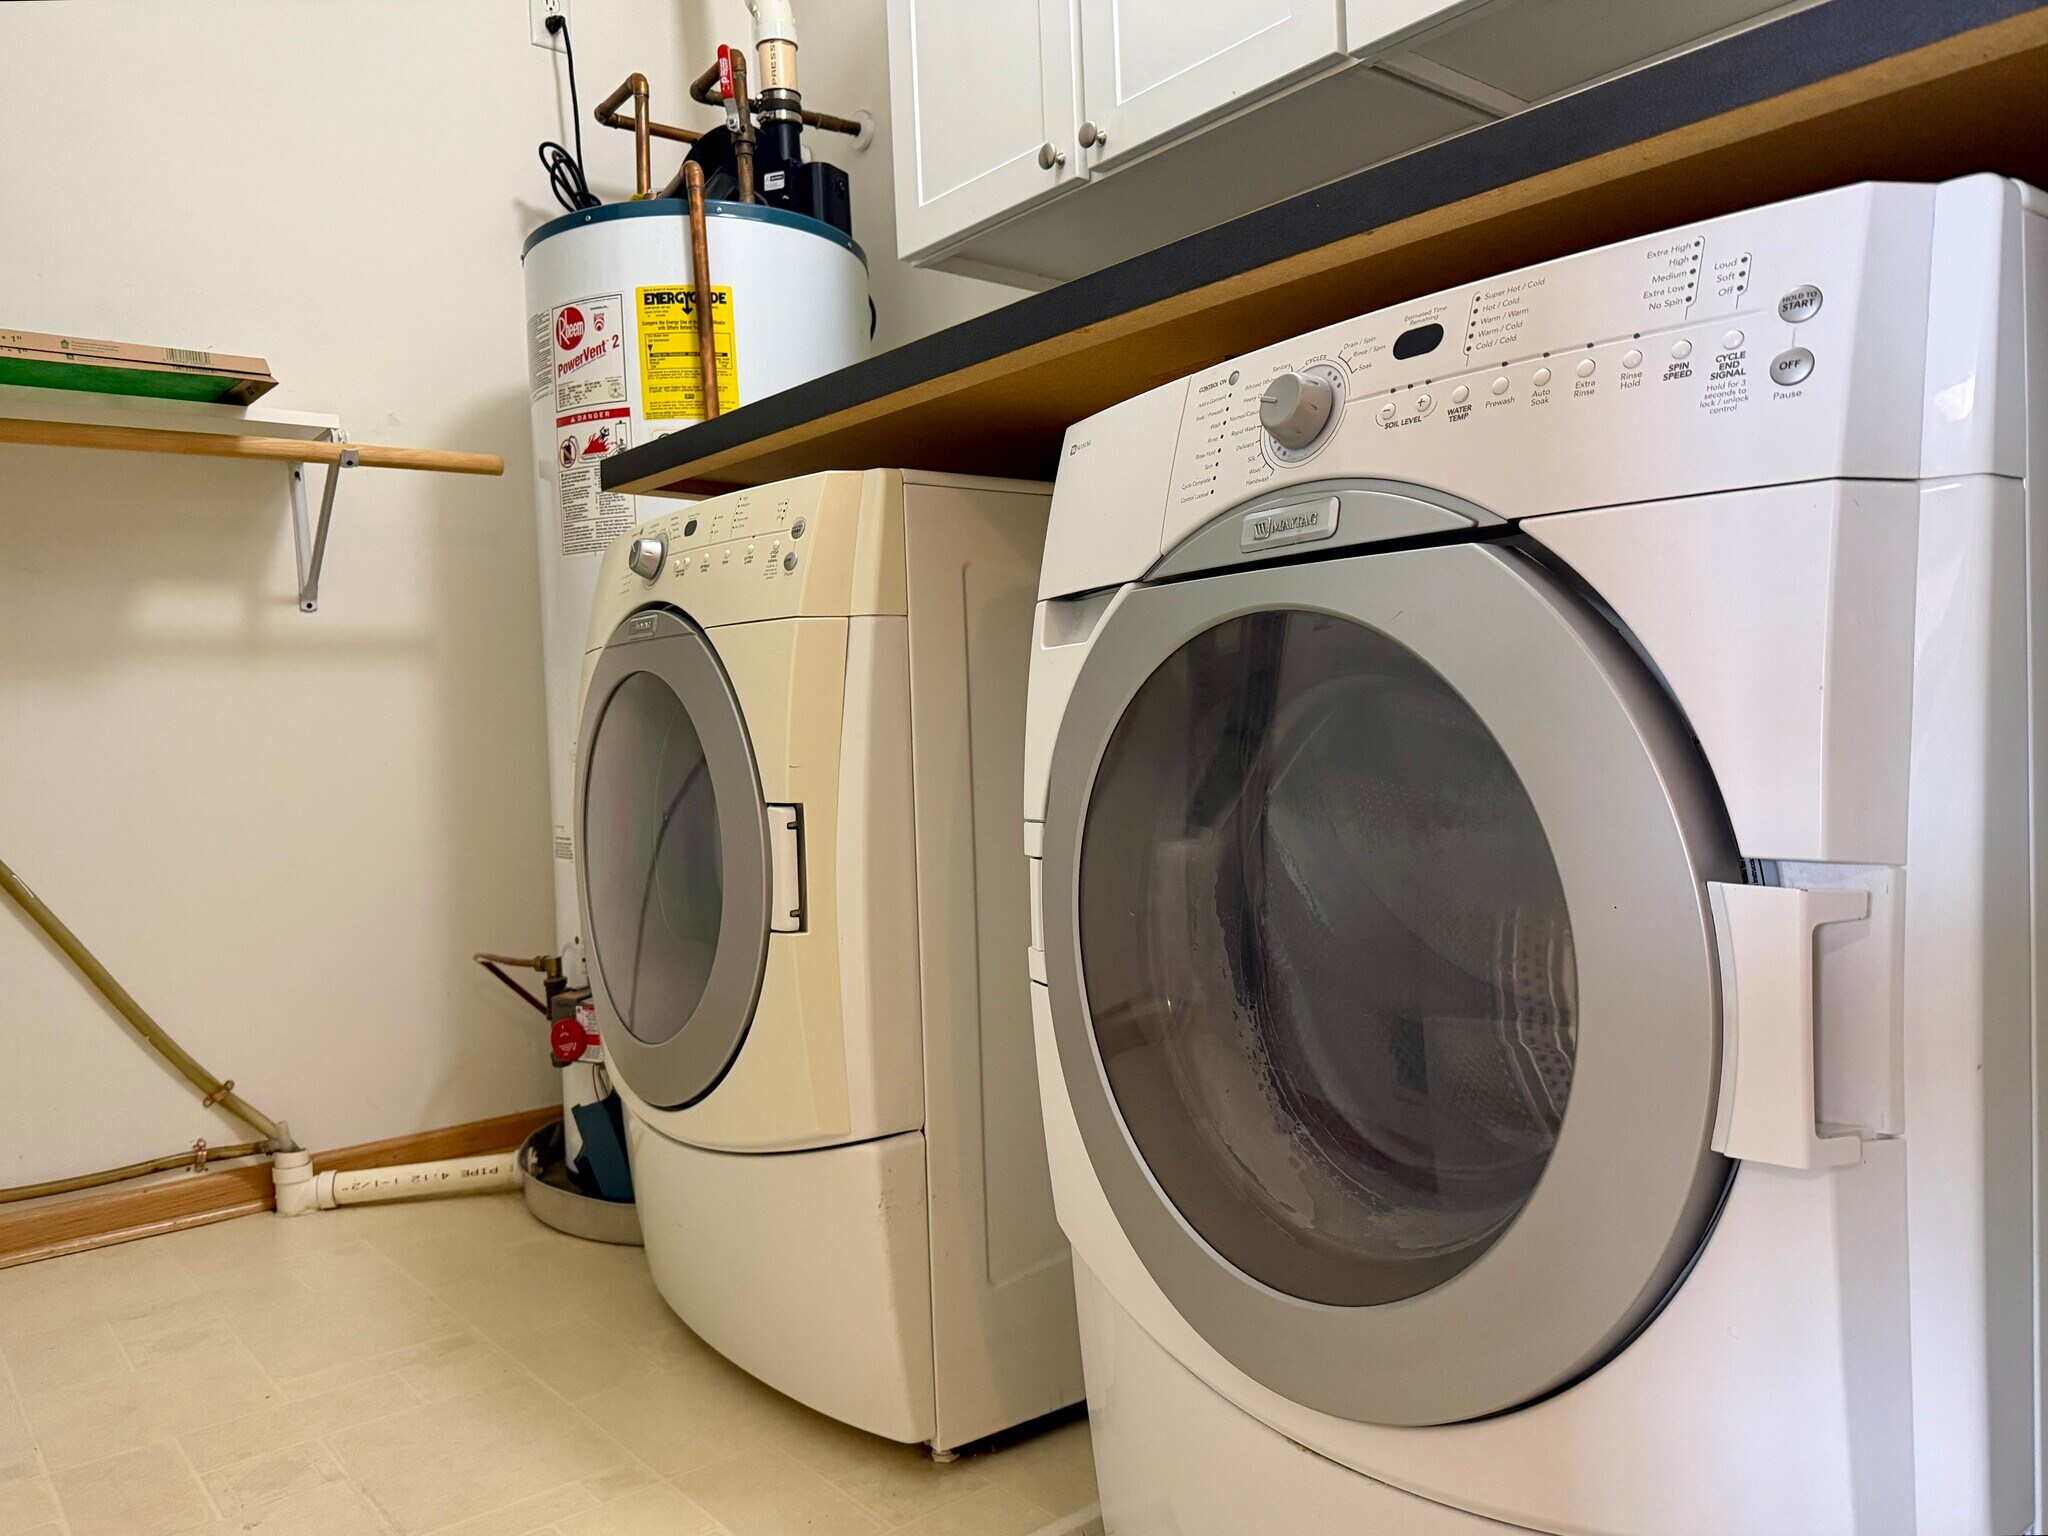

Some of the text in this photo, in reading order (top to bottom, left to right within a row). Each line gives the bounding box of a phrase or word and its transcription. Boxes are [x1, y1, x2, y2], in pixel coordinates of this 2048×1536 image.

[1647, 242, 1691, 259] Extra High
[1669, 256, 1690, 266] High
[1714, 258, 1738, 270] Loud
[1652, 270, 1687, 283] Medium
[1716, 272, 1735, 282] Soft
[1484, 290, 1506, 300] Super
[1507, 286, 1520, 294] Hot
[1528, 278, 1546, 289] Cold
[1643, 284, 1685, 299] Extra Low
[1718, 286, 1734, 296] Off
[1664, 298, 1683, 308] Spin
[1782, 293, 1804, 302] HOLD
[1482, 304, 1496, 312] Hot
[1502, 297, 1520, 307] Cold
[1782, 298, 1816, 312] START
[1404, 309, 1432, 321] Estimated
[1410, 315, 1439, 326] Remaining
[1480, 316, 1500, 324] Warm
[1508, 308, 1529, 318] Warm
[559, 309, 584, 345] Rheem
[1478, 328, 1498, 337] Warm
[1506, 321, 1523, 331] Cold
[612, 334, 620, 349] 2
[1343, 341, 1358, 350] Drain
[1476, 340, 1493, 350] Cold
[1500, 334, 1517, 344] Cold
[1305, 354, 1327, 366] CYCLES
[1716, 351, 1746, 363] CYCLE
[1272, 364, 1291, 372] Sanitary
[1359, 363, 1372, 371] Soak
[1668, 362, 1689, 372] SPIN
[1718, 361, 1740, 370] END
[1779, 360, 1801, 370] OFF
[1621, 371, 1643, 380] Rinse
[1663, 369, 1692, 381] SPEED
[1710, 368, 1746, 380] SIGNAL
[1199, 382, 1219, 393] CONTROL
[1575, 380, 1596, 389] Extra
[1620, 380, 1641, 390] Hold
[1706, 382, 1726, 392] Hold
[1728, 381, 1739, 390] for
[1532, 389, 1550, 398] Auto
[1574, 388, 1595, 398] Rinse
[1704, 389, 1736, 400] seconds
[1773, 390, 1802, 400] Pause
[1210, 395, 1226, 404] Garment
[1485, 397, 1515, 408] Prewash
[1531, 396, 1549, 406] Soak
[1700, 399, 1715, 408] lock
[1723, 394, 1749, 404] unlock
[1447, 404, 1472, 415] WATER
[1709, 404, 1737, 414] control
[577, 411, 610, 422] DANGER
[1401, 416, 1422, 426] LEVEL
[1449, 413, 1468, 422] TEMP
[1236, 442, 1254, 451] Delicate
[1192, 478, 1211, 486] Complete
[1246, 476, 1269, 486] Handwash
[1272, 513, 1318, 533] MAYTAG
[461, 1166, 498, 1177] PIPE
